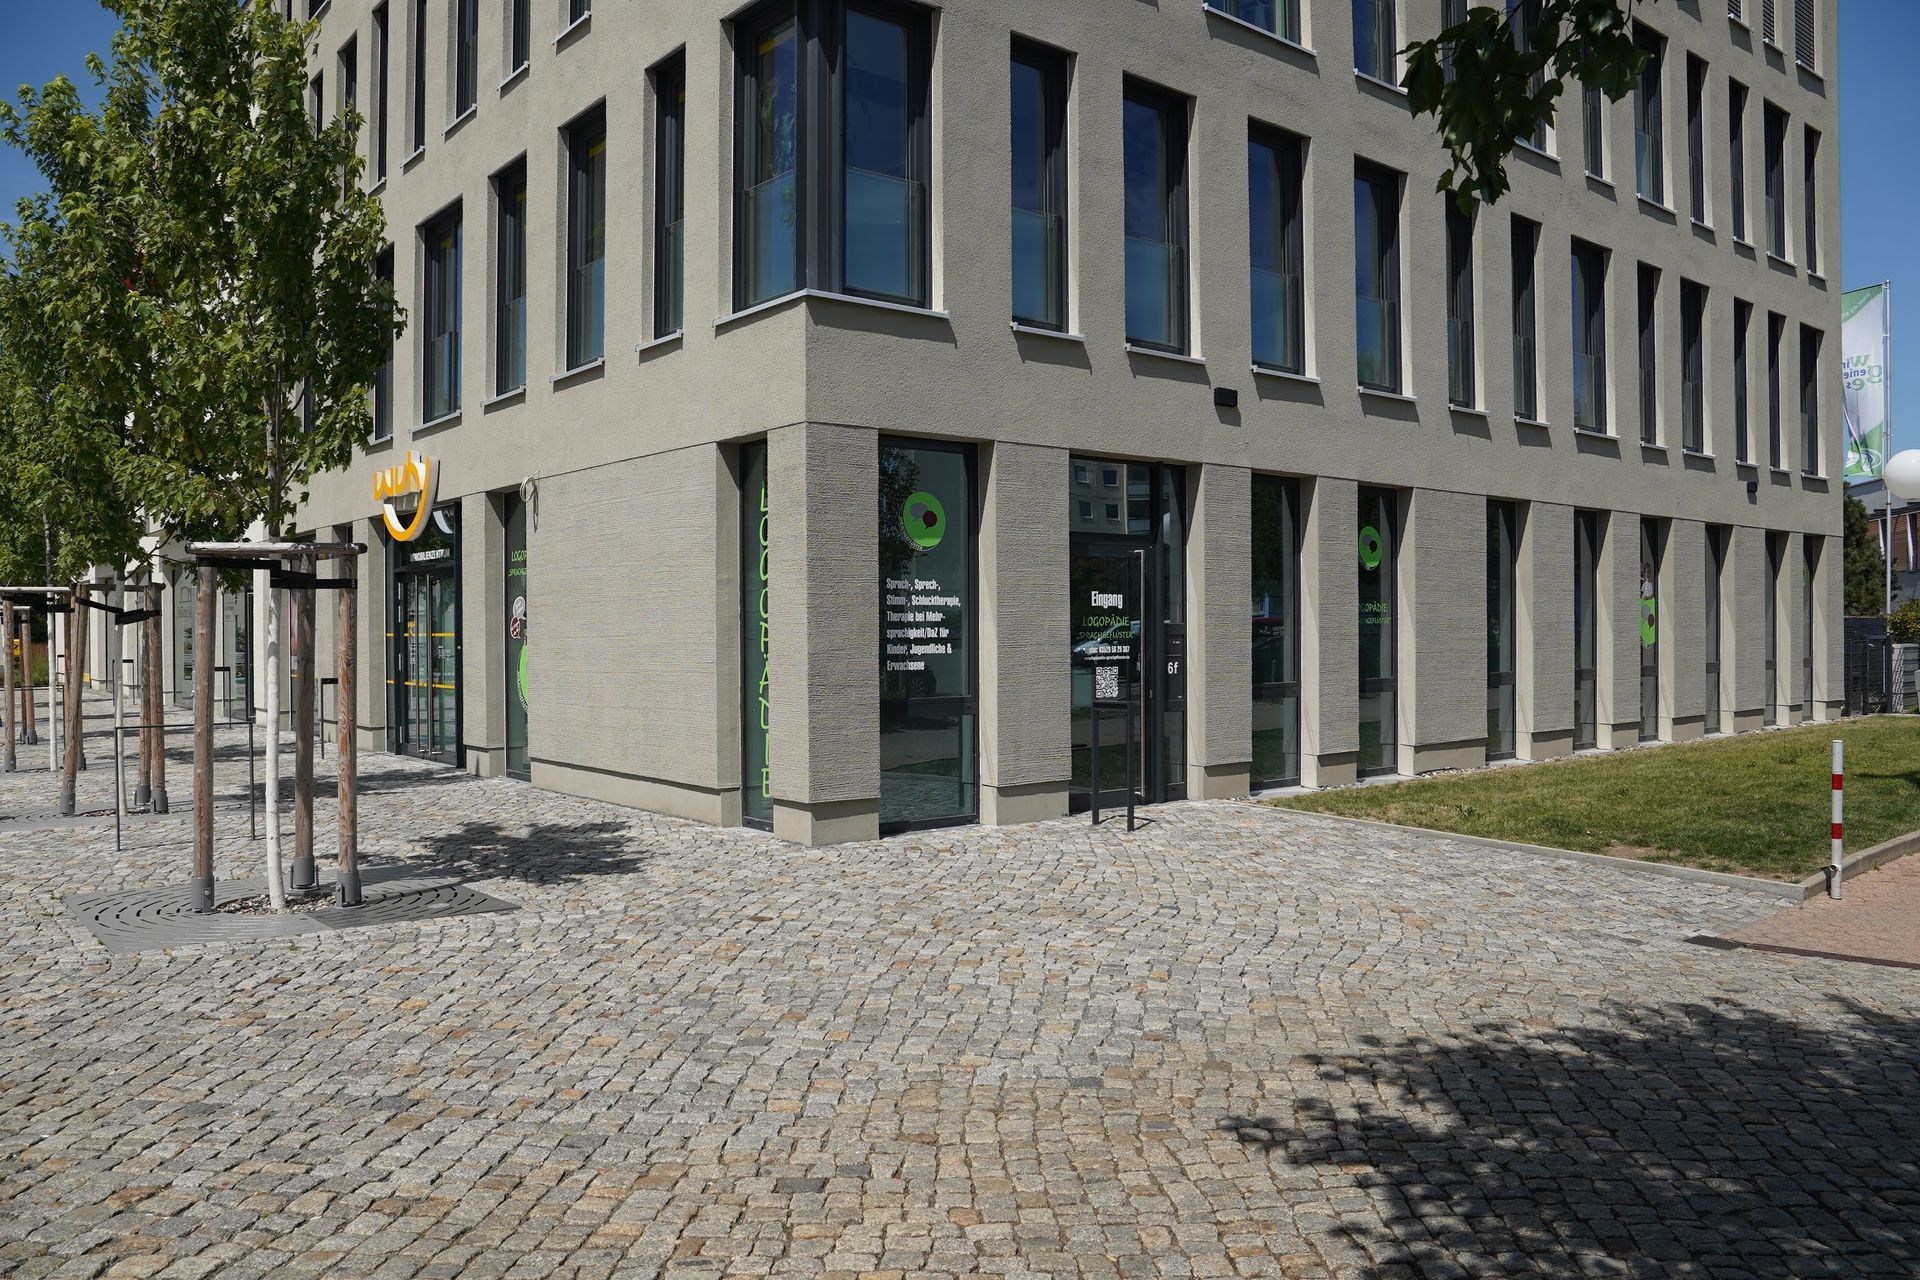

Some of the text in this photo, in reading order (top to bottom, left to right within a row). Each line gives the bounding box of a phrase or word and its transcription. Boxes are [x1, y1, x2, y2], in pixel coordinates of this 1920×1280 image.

[1091, 590, 1123, 609] Eingang
[886, 611, 946, 623] Therapie bei Mehr-
[1082, 613, 1130, 628] LOGOPÄDIE
[939, 627, 949, 638] für
[886, 643, 952, 656] Kinder, Jugendliche &
[886, 660, 925, 671] Erwachsene
[1167, 661, 1179, 675] 6f
